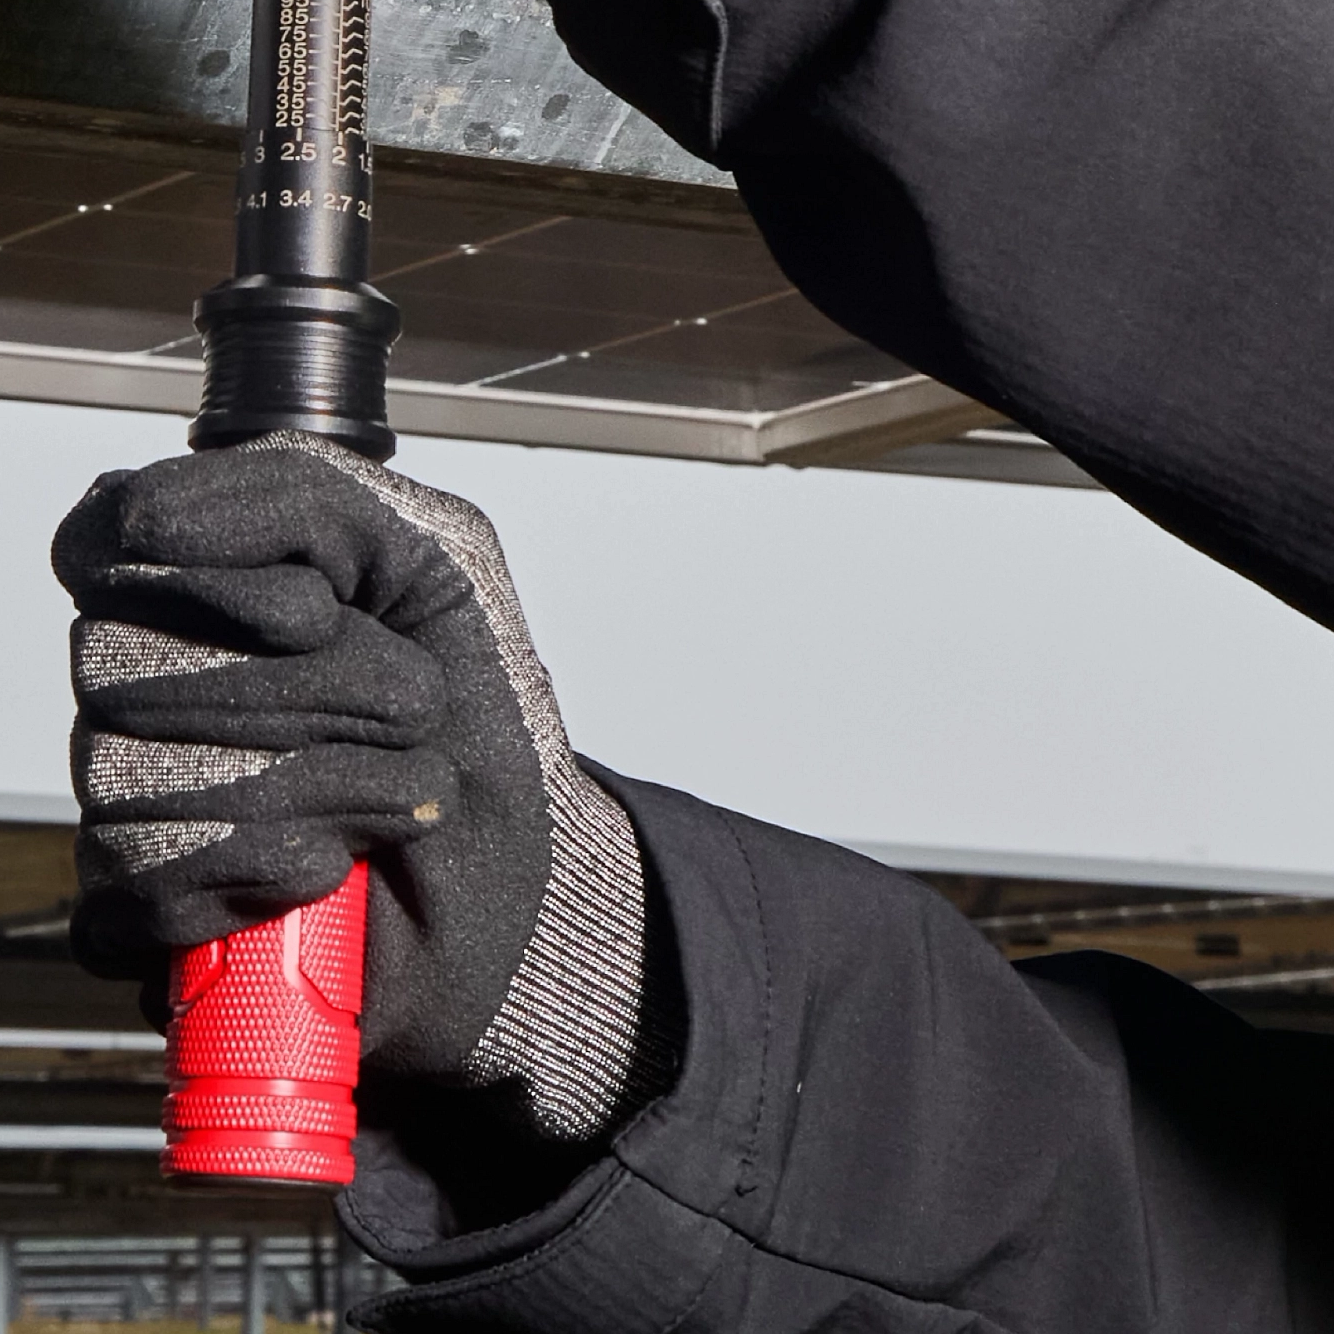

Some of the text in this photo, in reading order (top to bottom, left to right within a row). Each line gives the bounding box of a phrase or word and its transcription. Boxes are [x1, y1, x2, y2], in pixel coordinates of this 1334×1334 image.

[279, 8, 309, 26] 85
[279, 25, 308, 42] 75
[278, 42, 307, 59] 65
[277, 59, 307, 76] 55
[277, 76, 306, 93] 45
[276, 93, 305, 110] 35
[275, 110, 305, 128] 25
[254, 145, 265, 164] 3
[280, 142, 318, 161] 2.5
[331, 145, 347, 166] 2
[246, 190, 267, 210] 4.1
[279, 189, 313, 207] 3.4
[323, 192, 353, 213] 2.7
